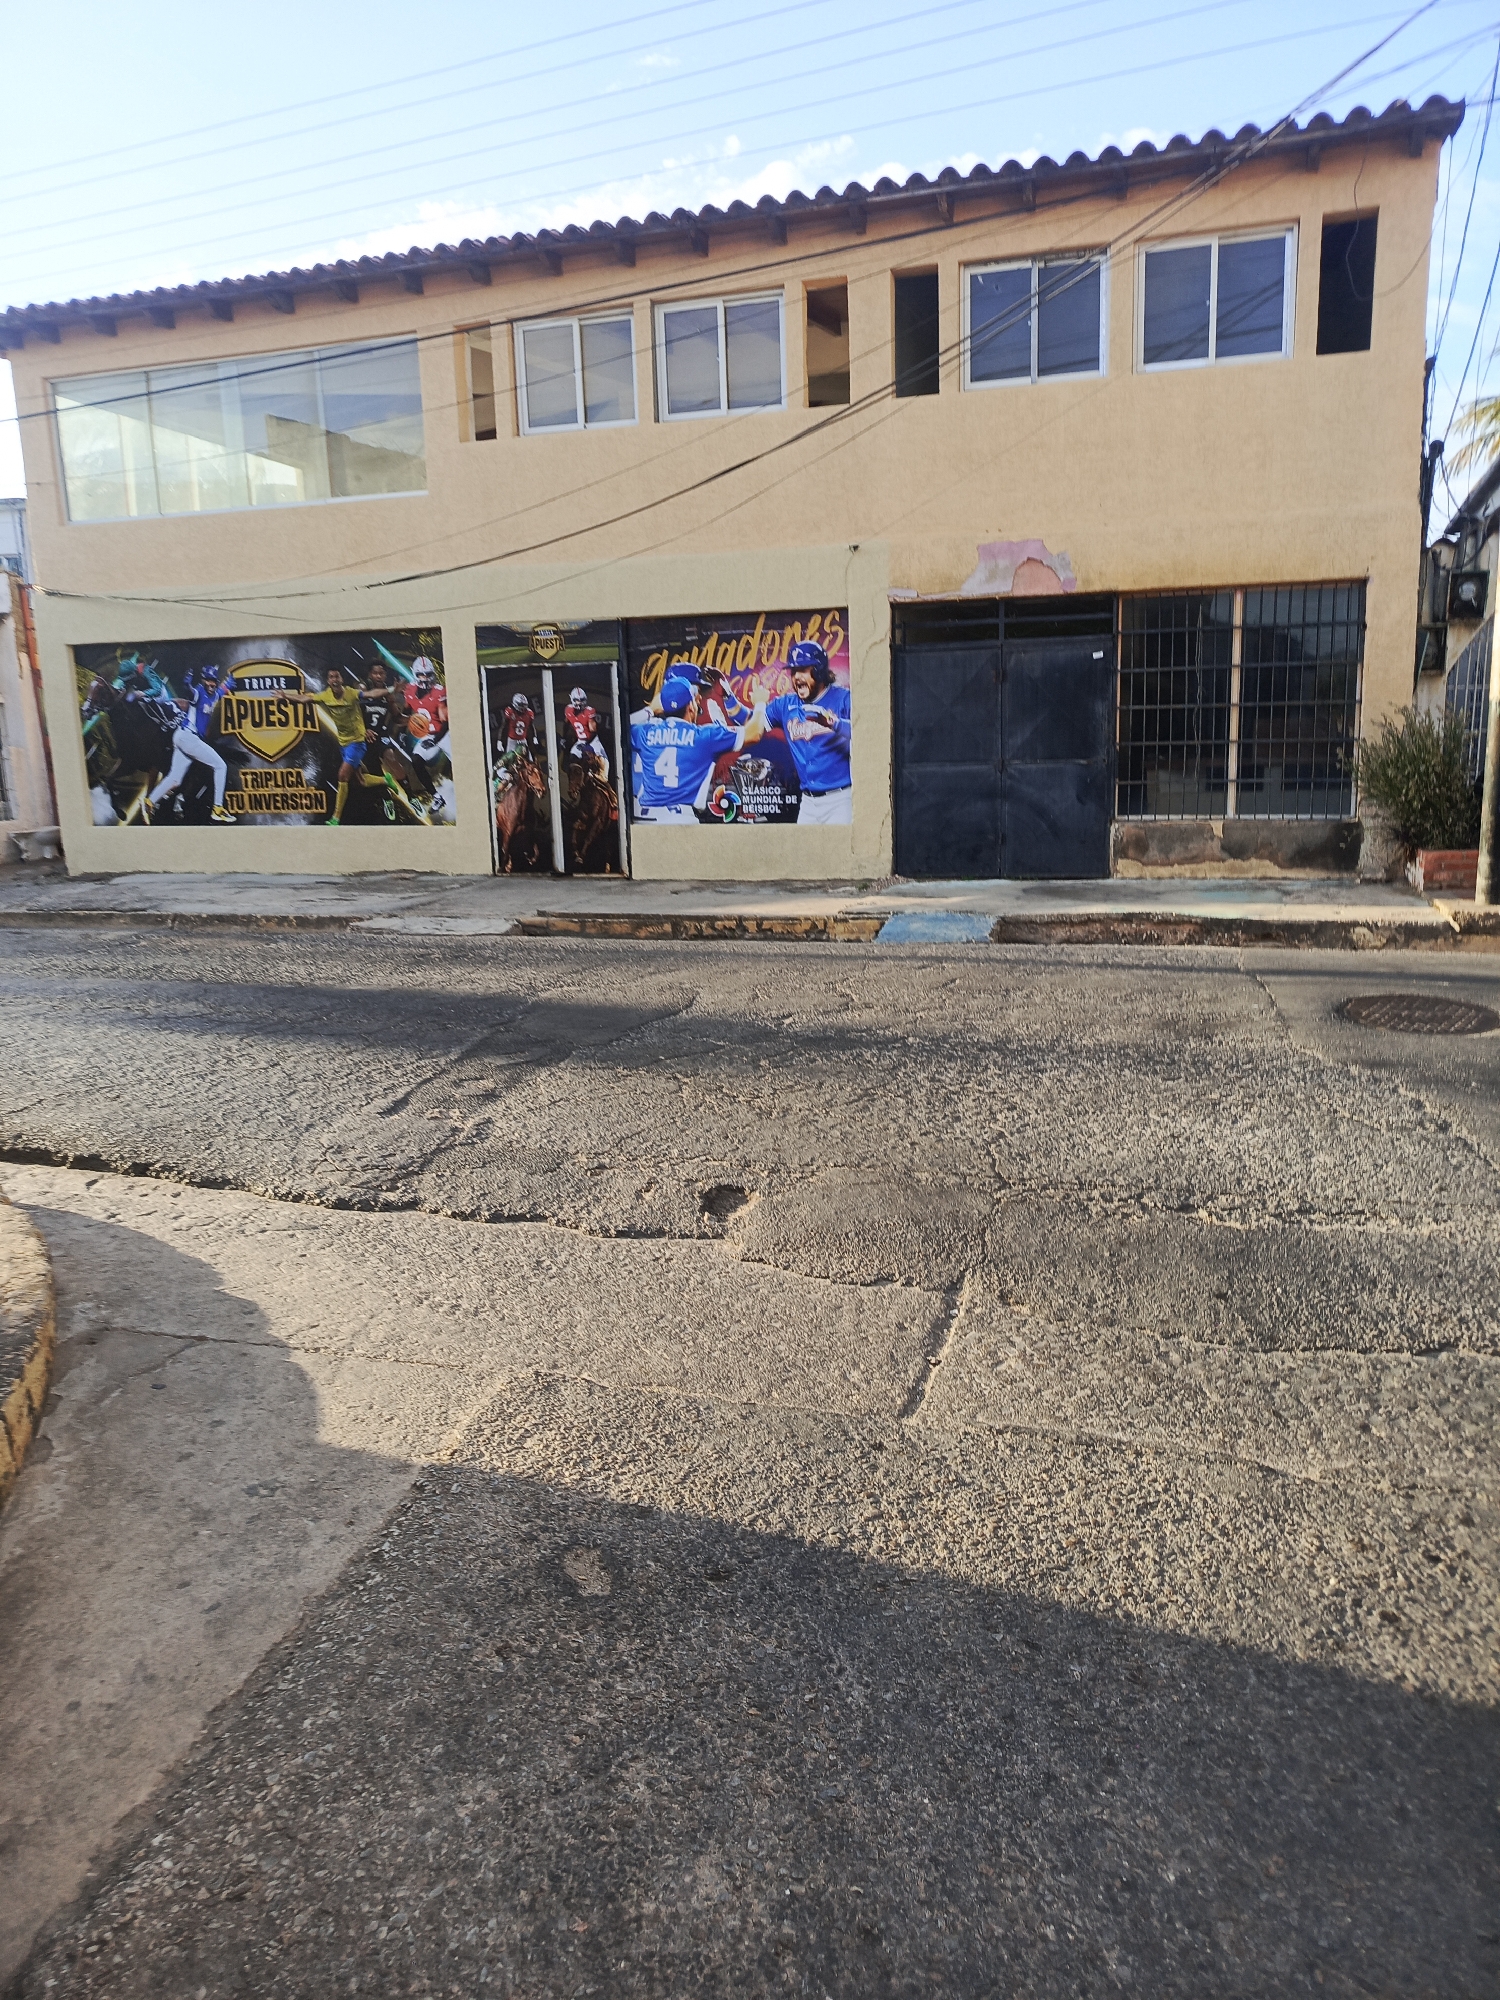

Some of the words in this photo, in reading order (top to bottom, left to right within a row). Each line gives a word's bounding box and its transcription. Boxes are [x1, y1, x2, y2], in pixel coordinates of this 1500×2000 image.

[529, 636, 565, 651] APUESTA
[243, 677, 287, 690] TRIPLE
[223, 697, 318, 731] APUESTA
[573, 721, 587, 740] 2
[647, 728, 695, 746] SANOJA
[654, 746, 679, 788] 4
[241, 771, 305, 788] TRIPLICA
[227, 793, 245, 810] TU
[742, 795, 783, 804] MUNDIAL
[785, 795, 798, 804] DE
